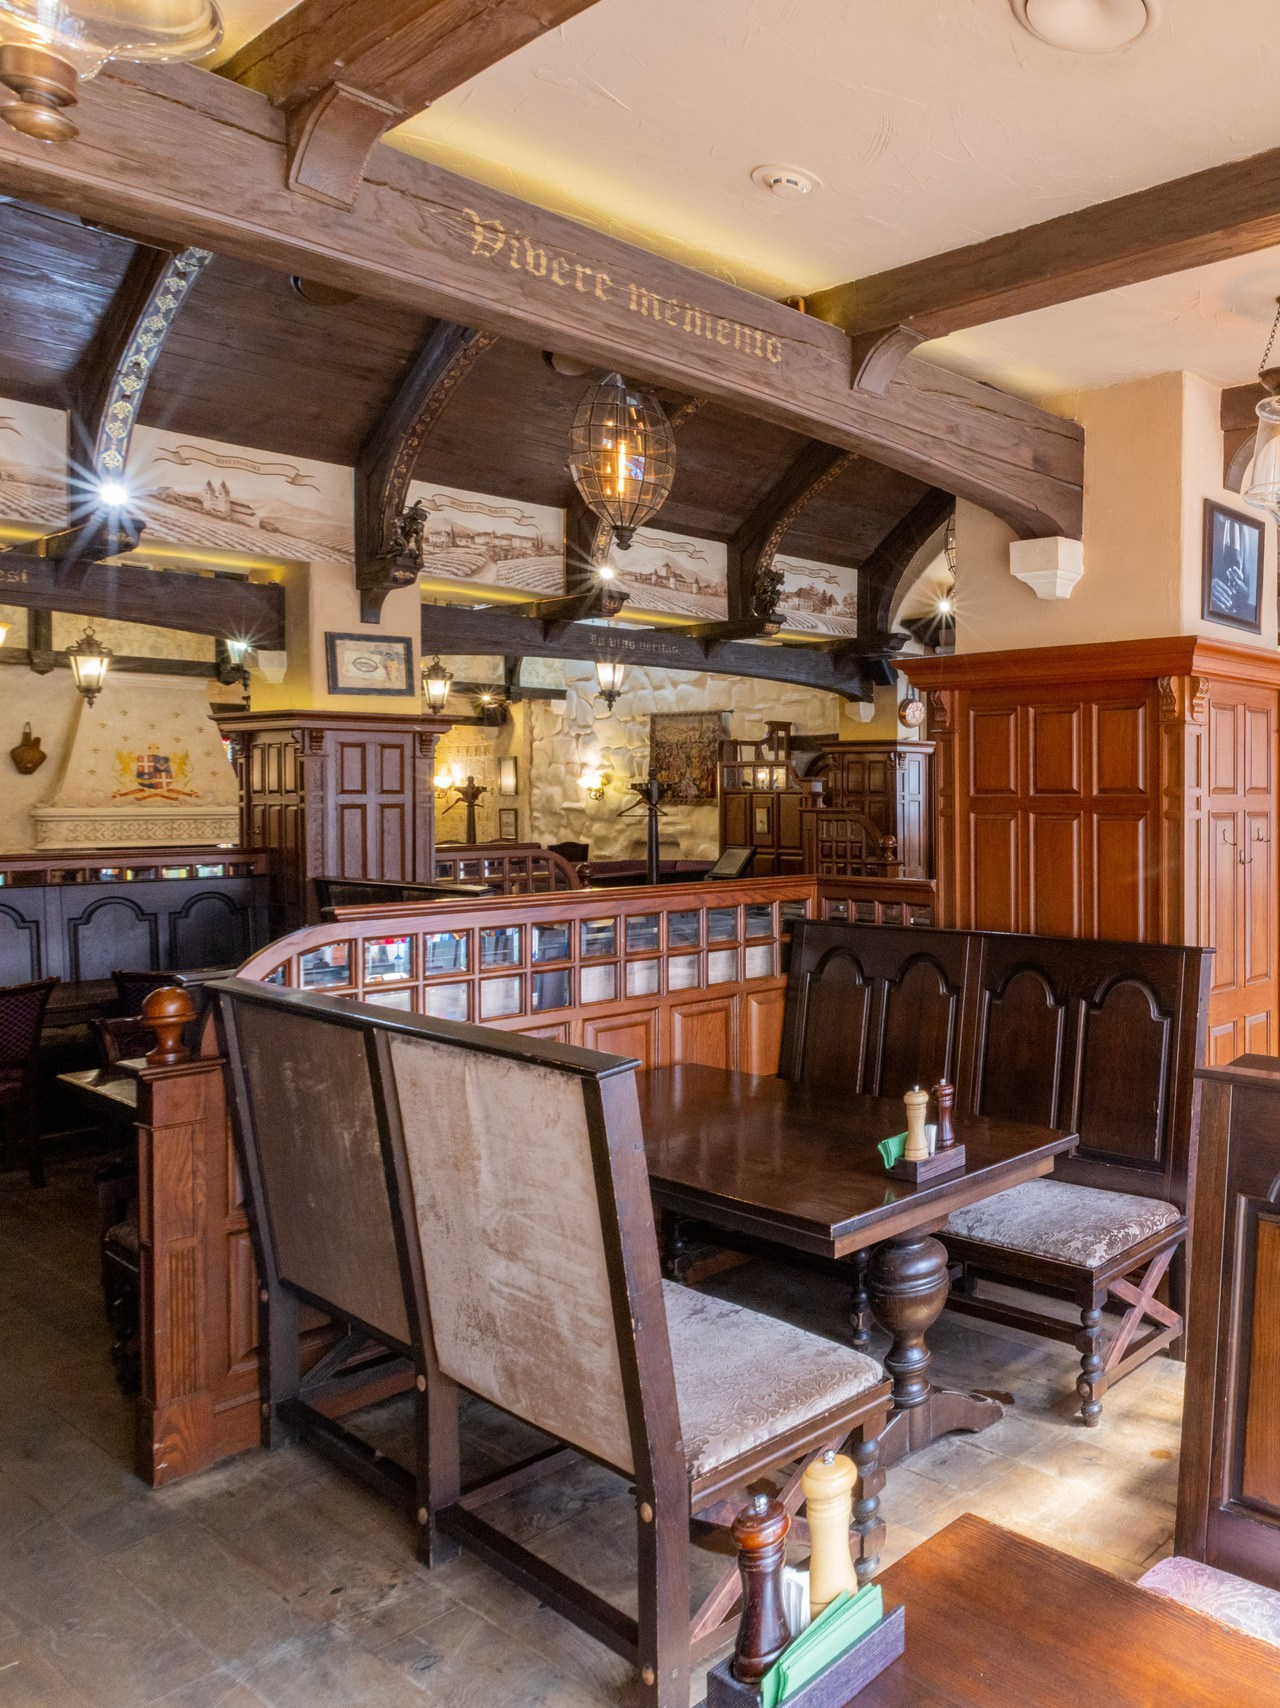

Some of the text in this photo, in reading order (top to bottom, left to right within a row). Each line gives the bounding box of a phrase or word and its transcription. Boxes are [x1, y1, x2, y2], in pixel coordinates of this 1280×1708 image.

[463, 207, 784, 364] Vivere memento
[608, 636, 636, 650] vino
